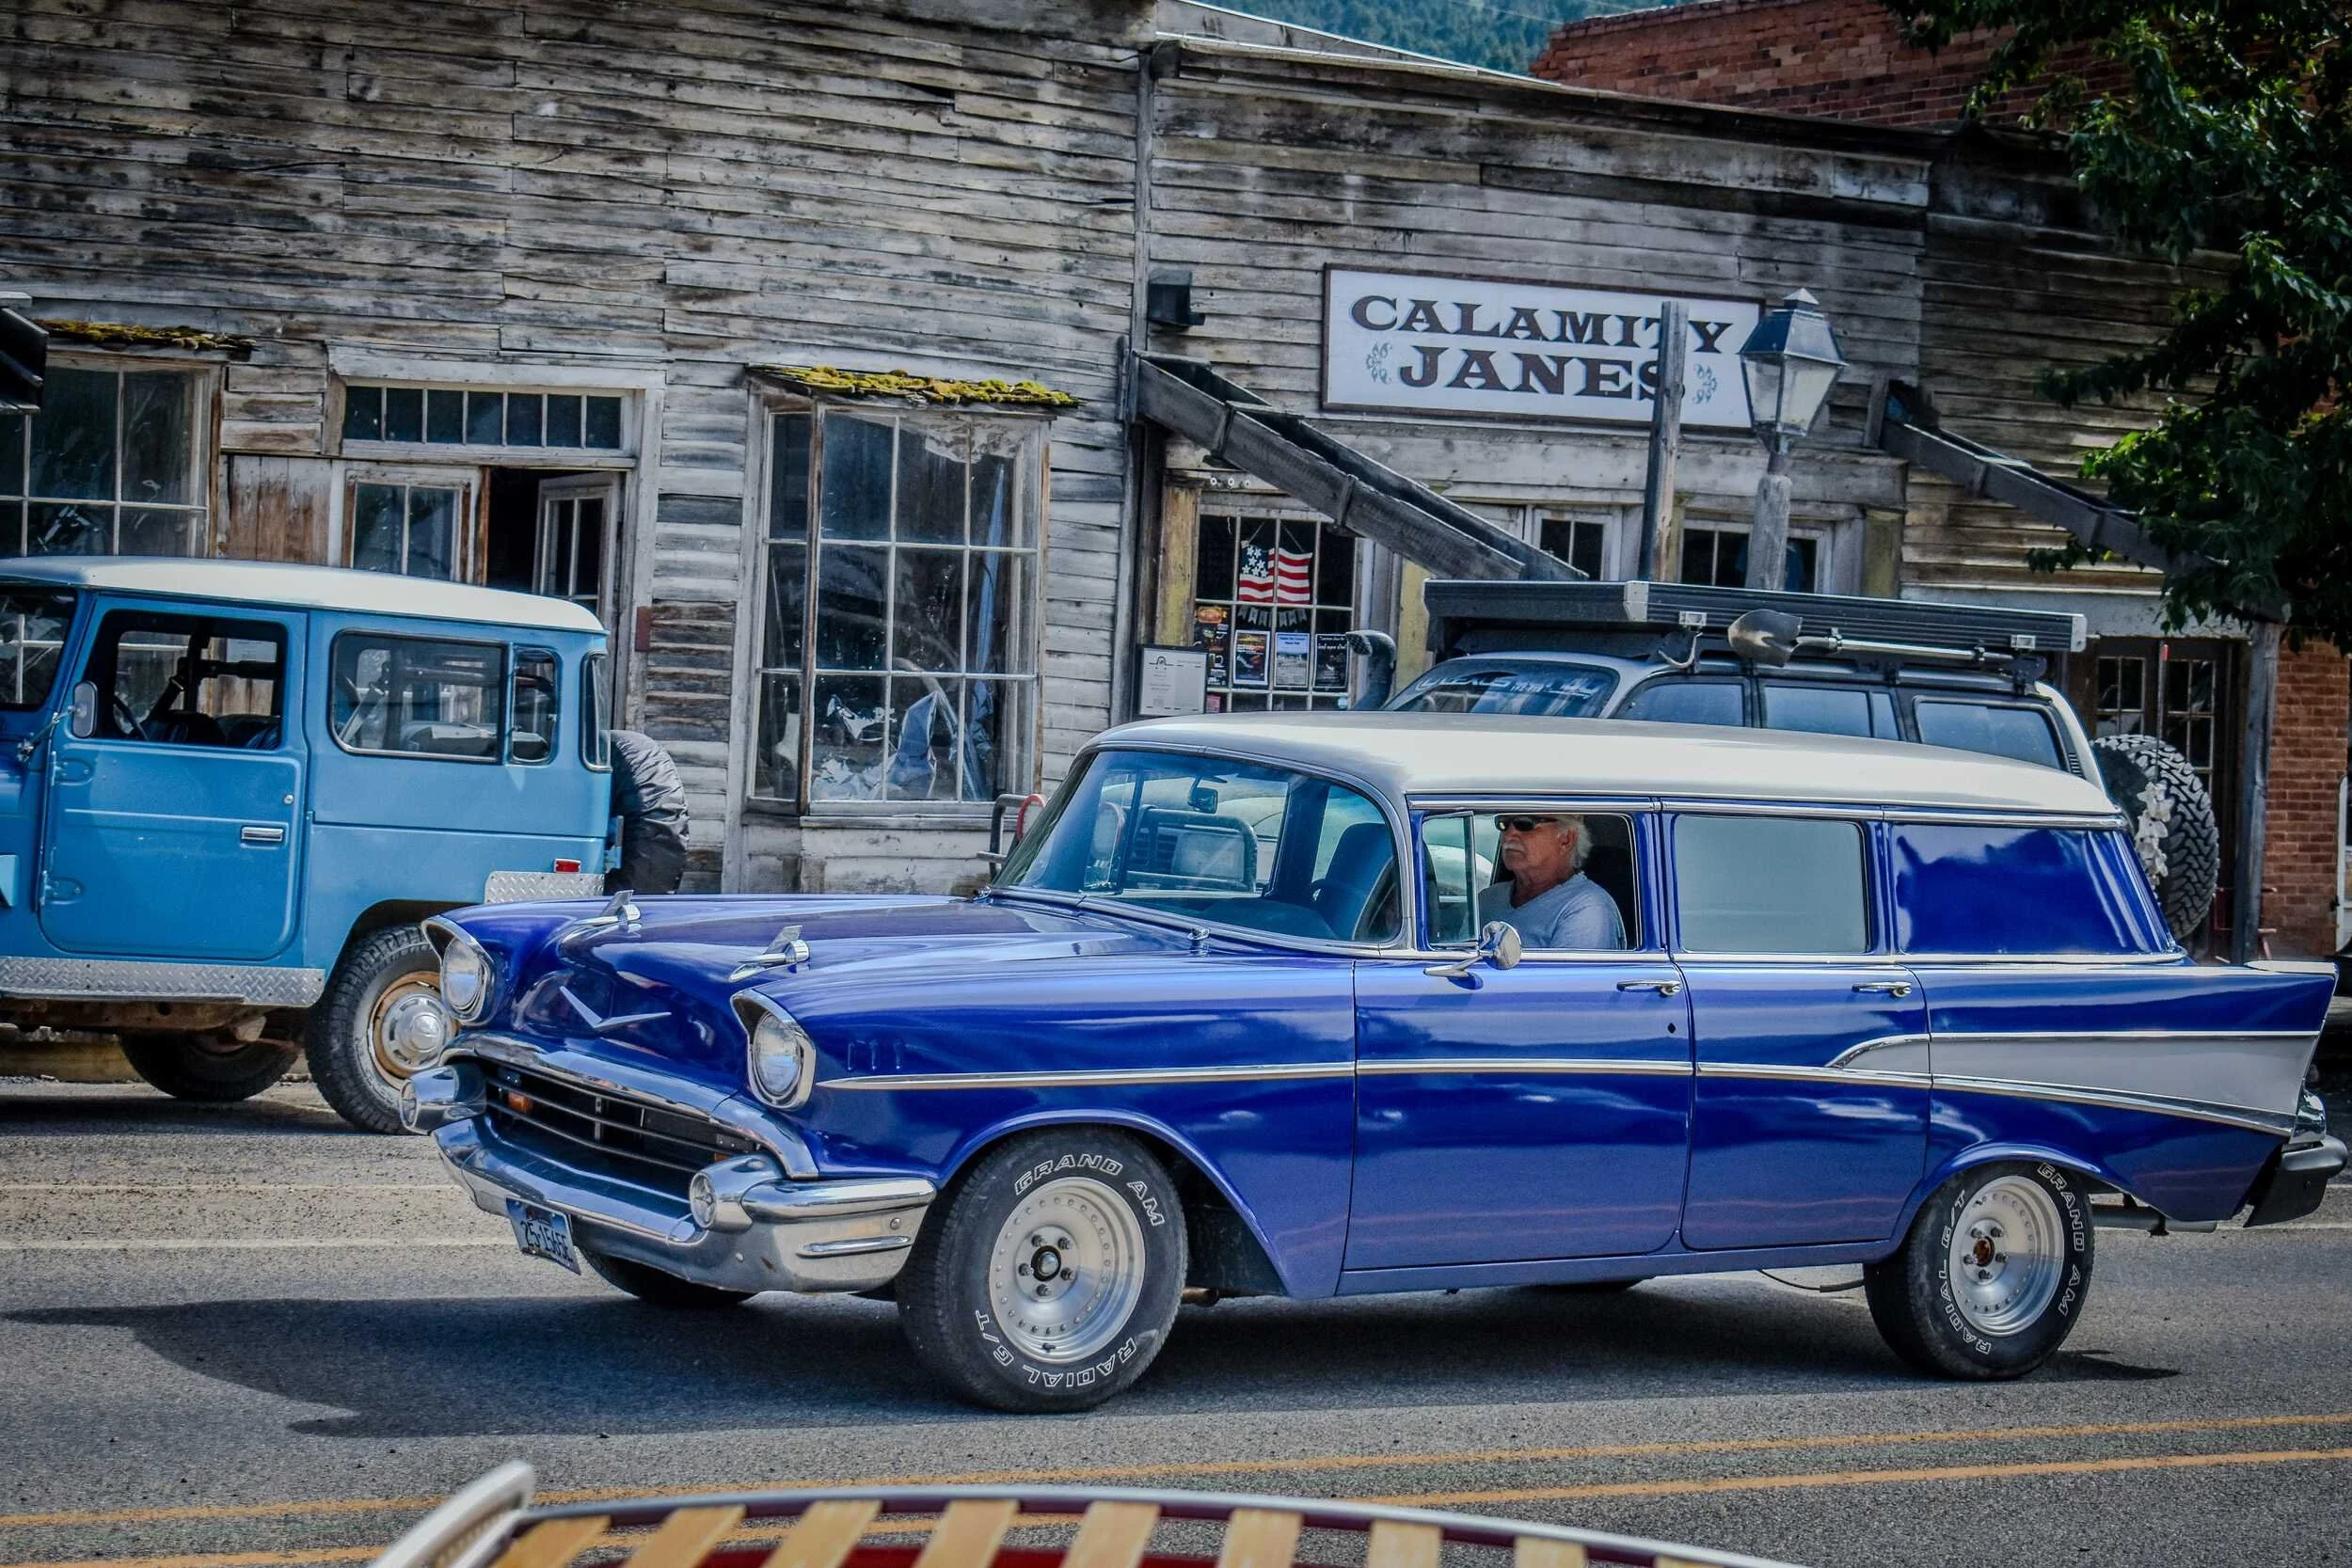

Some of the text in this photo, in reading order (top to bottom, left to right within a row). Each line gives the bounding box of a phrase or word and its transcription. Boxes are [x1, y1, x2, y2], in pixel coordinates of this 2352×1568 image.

[1015, 1153, 1166, 1227] GRAND AM
[2037, 1163, 2085, 1317] GRAND AM
[1938, 1189, 1992, 1356] RADIAL G/T
[975, 1308, 1137, 1388] RADIAL G/T
